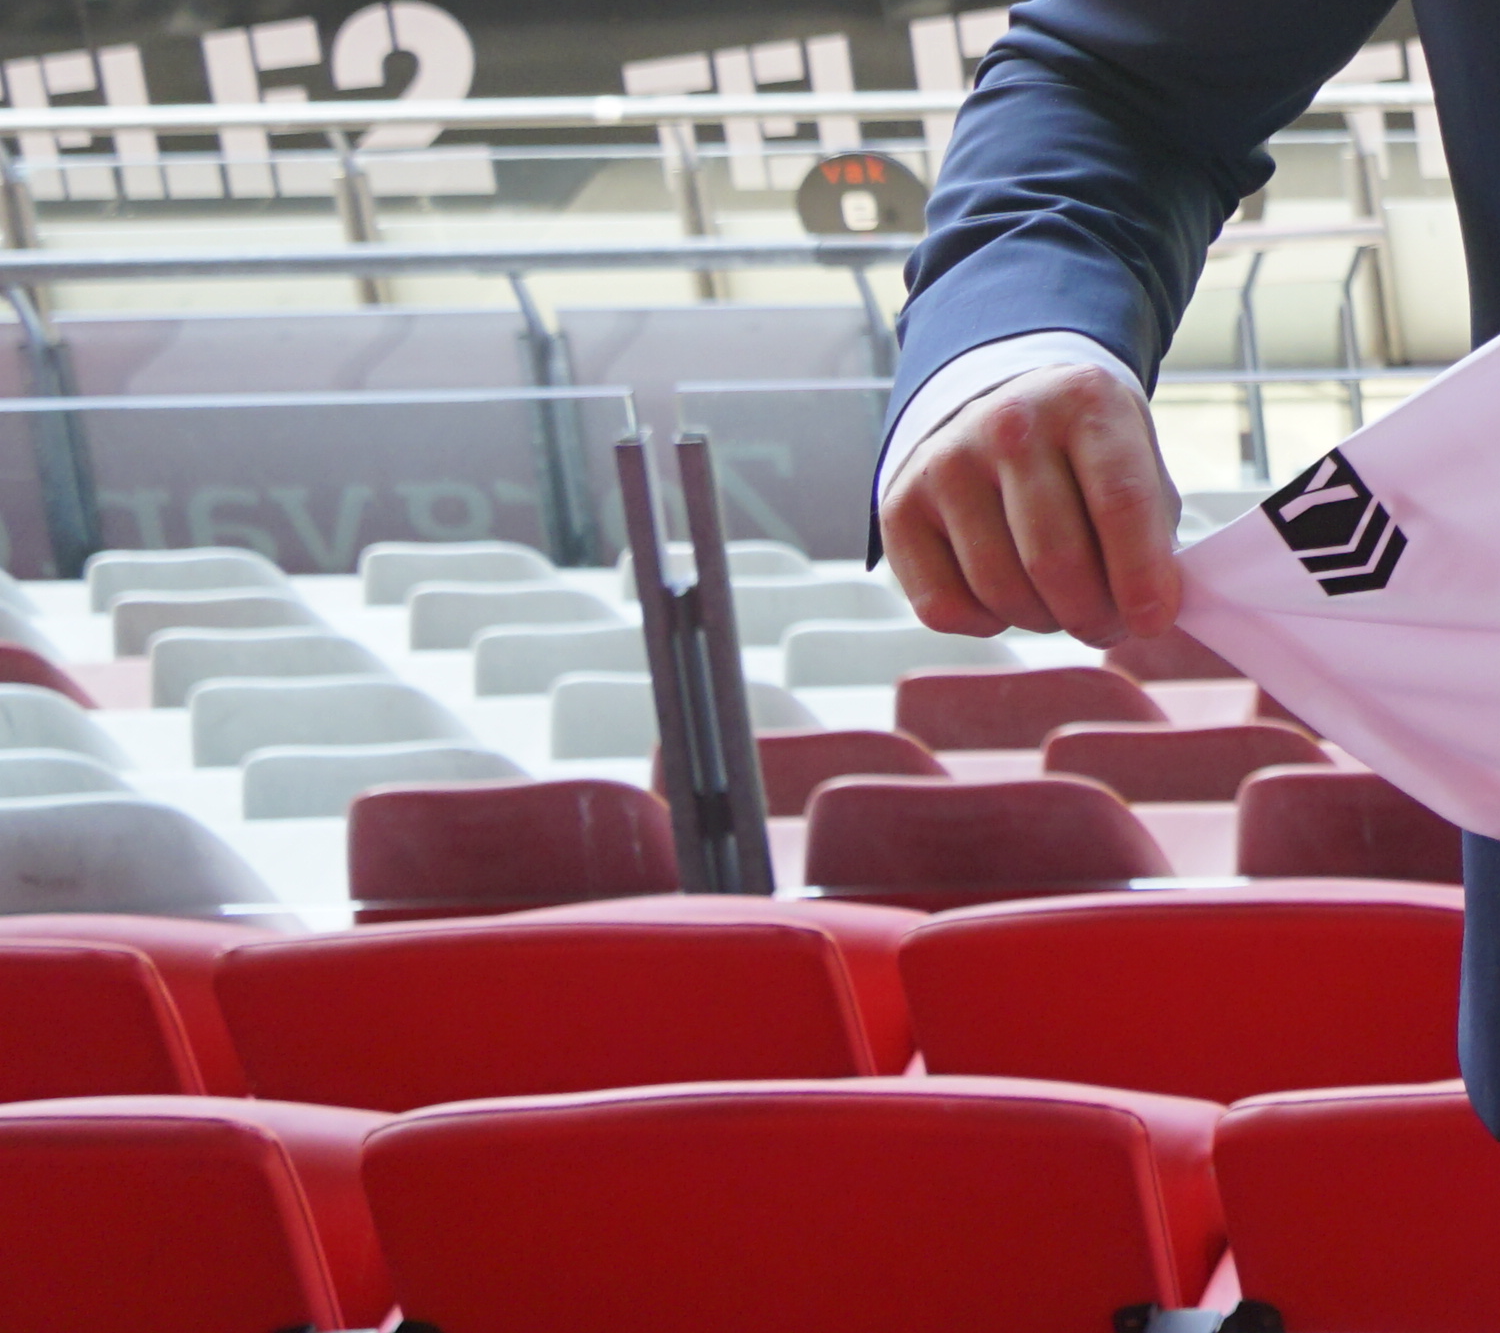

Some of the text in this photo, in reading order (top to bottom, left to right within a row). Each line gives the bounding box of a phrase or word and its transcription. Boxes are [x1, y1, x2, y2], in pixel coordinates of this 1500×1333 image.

[0, 0, 498, 201] ELE2
[622, 3, 1012, 195] TEL
[819, 154, 887, 185] vak
